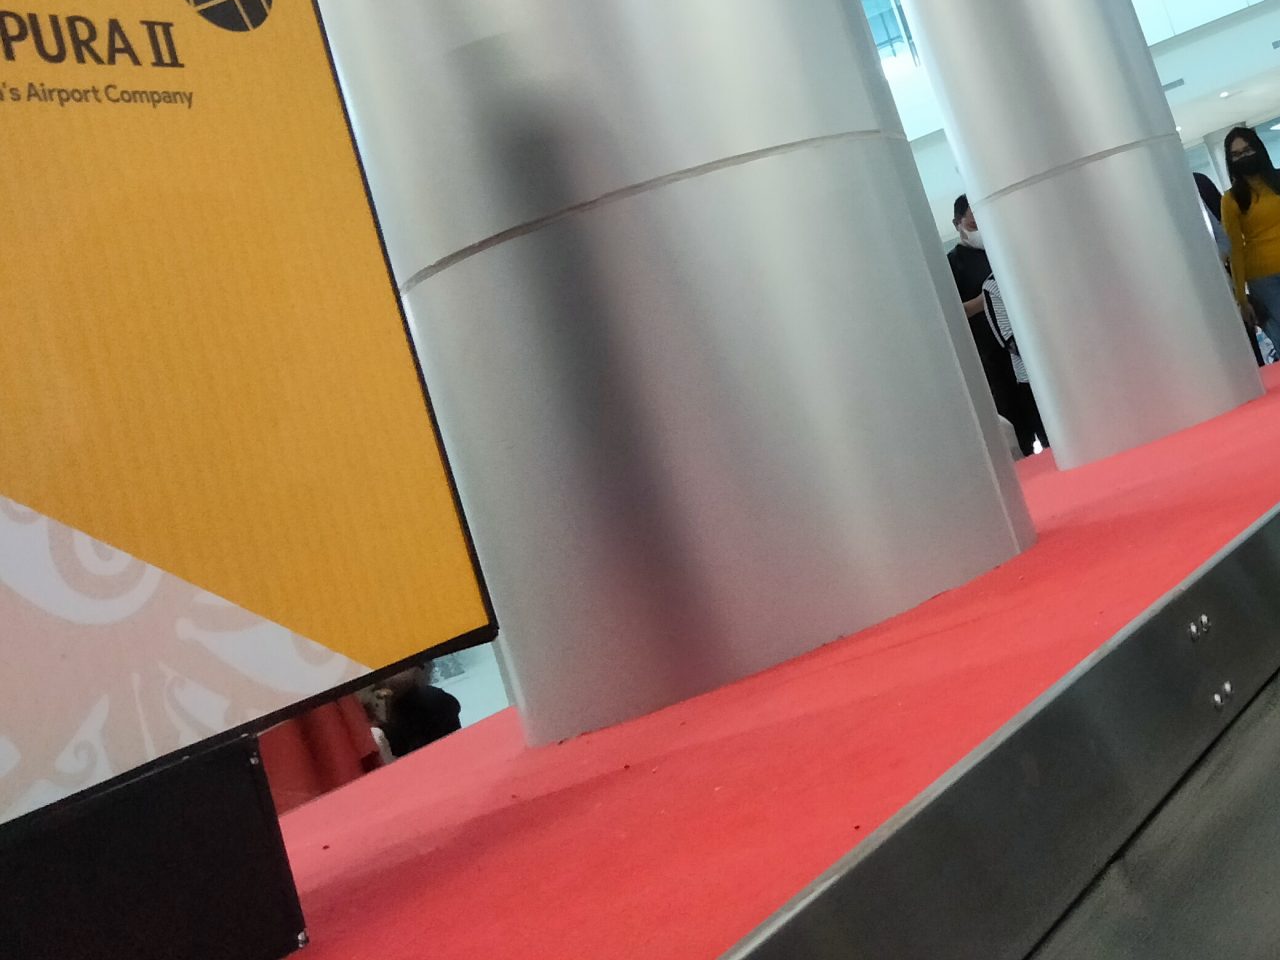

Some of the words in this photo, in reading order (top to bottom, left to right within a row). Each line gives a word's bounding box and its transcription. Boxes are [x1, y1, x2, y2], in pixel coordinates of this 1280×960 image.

[0, 10, 142, 66] PURA
[139, 20, 185, 68] II
[27, 82, 102, 107] Airport
[104, 84, 193, 109] Company
